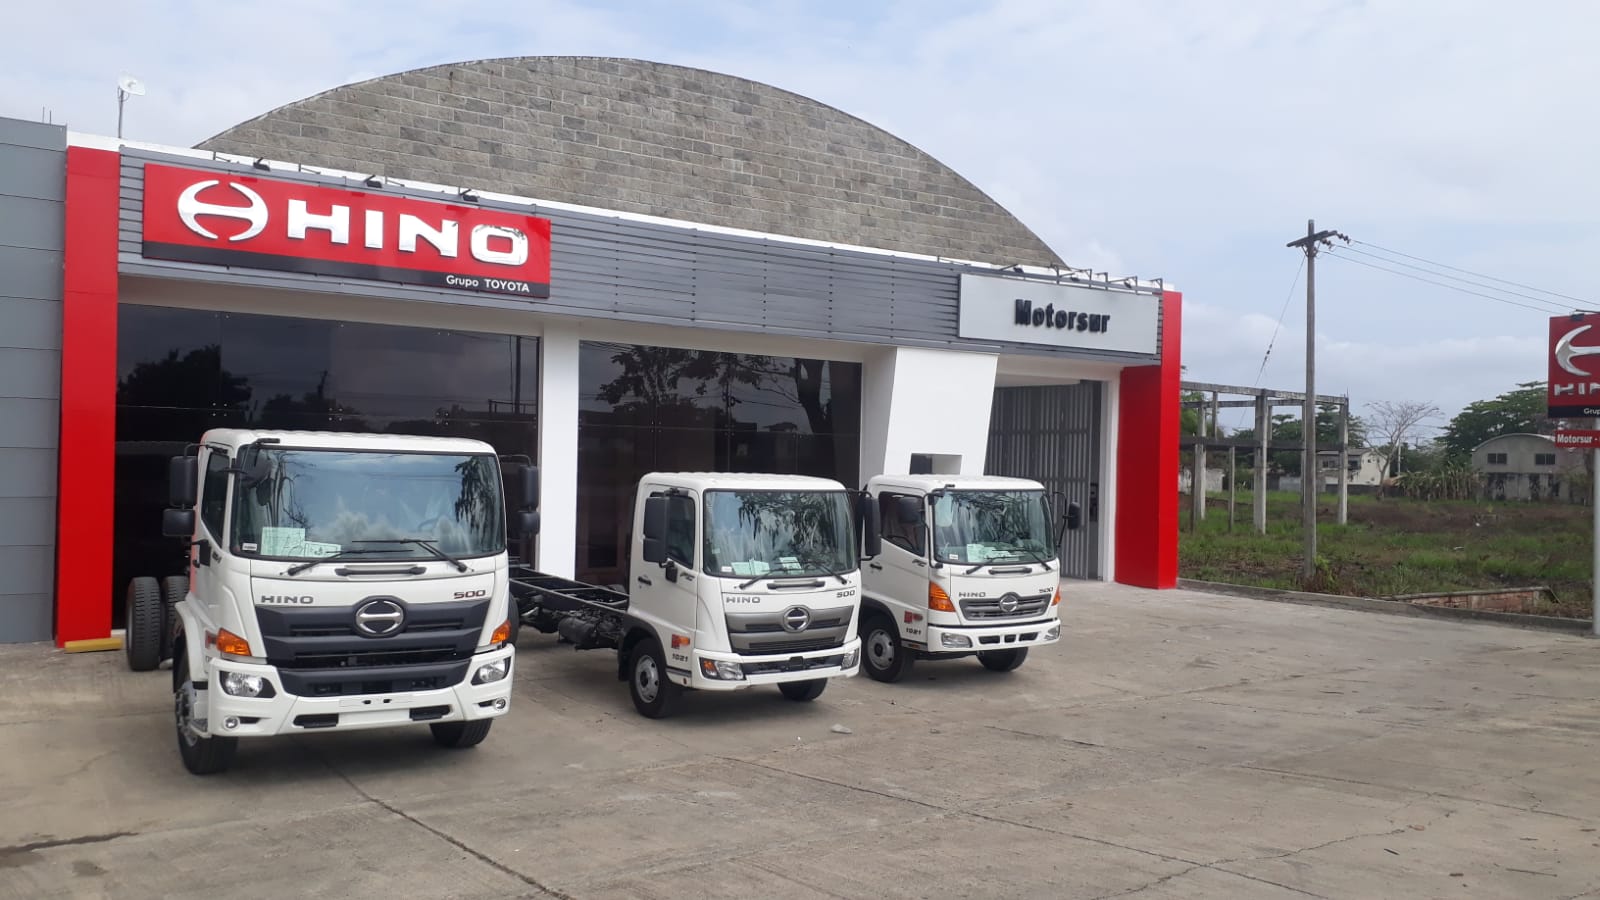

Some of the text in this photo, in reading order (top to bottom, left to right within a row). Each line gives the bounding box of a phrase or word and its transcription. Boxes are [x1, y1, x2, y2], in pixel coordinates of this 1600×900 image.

[287, 199, 529, 266] HINO
[446, 274, 531, 293] Grupo TOYOTA
[1015, 299, 1110, 333] Motorsur
[1557, 434, 1592, 444] Motorsur
[453, 589, 486, 600] 500
[836, 589, 856, 598] 500
[260, 595, 314, 605] HINO
[726, 596, 761, 604] HINO
